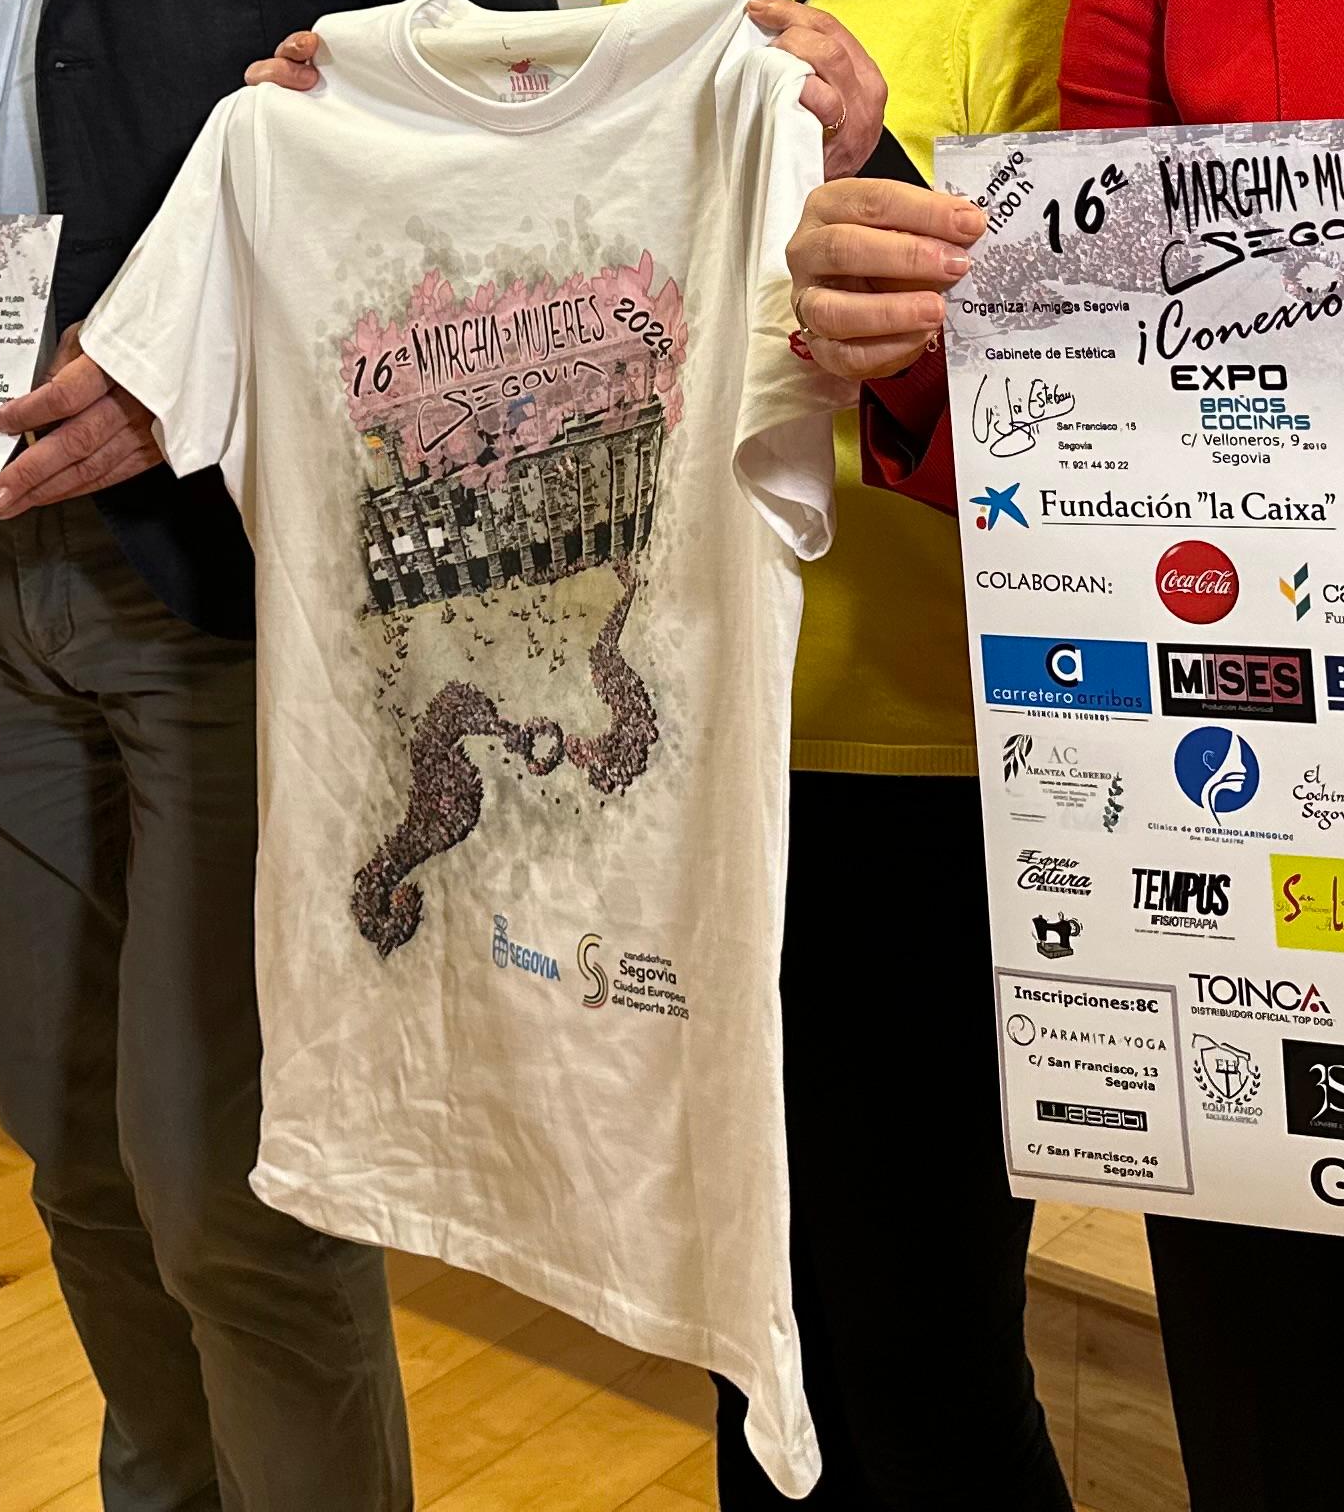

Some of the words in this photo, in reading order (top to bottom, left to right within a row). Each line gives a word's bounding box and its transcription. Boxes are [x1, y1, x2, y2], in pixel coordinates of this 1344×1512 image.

[986, 151, 1024, 196] mayo
[1032, 300, 1081, 316] Amig@s
[1084, 300, 1130, 315] Segovia
[514, 294, 605, 361] MUJERES
[612, 297, 674, 361] 2024
[985, 347, 1042, 360] Gabinete
[1046, 347, 1062, 360] de
[1065, 346, 1116, 360] Estética
[1170, 364, 1288, 391] EXPO
[417, 360, 607, 453] SEGOVIA
[1200, 394, 1286, 413] BAÑOS
[1056, 422, 1073, 431] San
[1200, 414, 1311, 431] COCINAS
[1058, 441, 1093, 452] Segovia
[1203, 434, 1285, 449] Velloneros,
[1291, 434, 1300, 446] 9
[1091, 460, 1102, 470] 44
[1105, 461, 1116, 470] 30
[1212, 452, 1271, 467] Segovia
[1039, 490, 1192, 520] Fundación
[976, 570, 1113, 595] COLABORAN:
[1169, 657, 1302, 701] MISES
[992, 686, 1074, 704] carretero
[1077, 690, 1144, 709] arribas
[1304, 764, 1322, 784] El
[1131, 867, 1232, 917] TEMPUS
[509, 942, 561, 982] SEGOVIA
[624, 951, 672, 967] candidatura
[620, 960, 677, 985] Segovia
[614, 979, 645, 996] Ciudad
[648, 986, 686, 1004] Europea
[1188, 973, 1331, 1014] TOINCA
[627, 997, 665, 1015] Deporte
[667, 1005, 689, 1020] 2025
[1040, 1027, 1117, 1046] PARAMITA
[1124, 1035, 1168, 1051] YOGA
[1047, 1056, 1071, 1069] San
[1074, 1059, 1139, 1077] Francisco,
[1142, 1067, 1159, 1078] 13
[1105, 1076, 1155, 1091] Segovia
